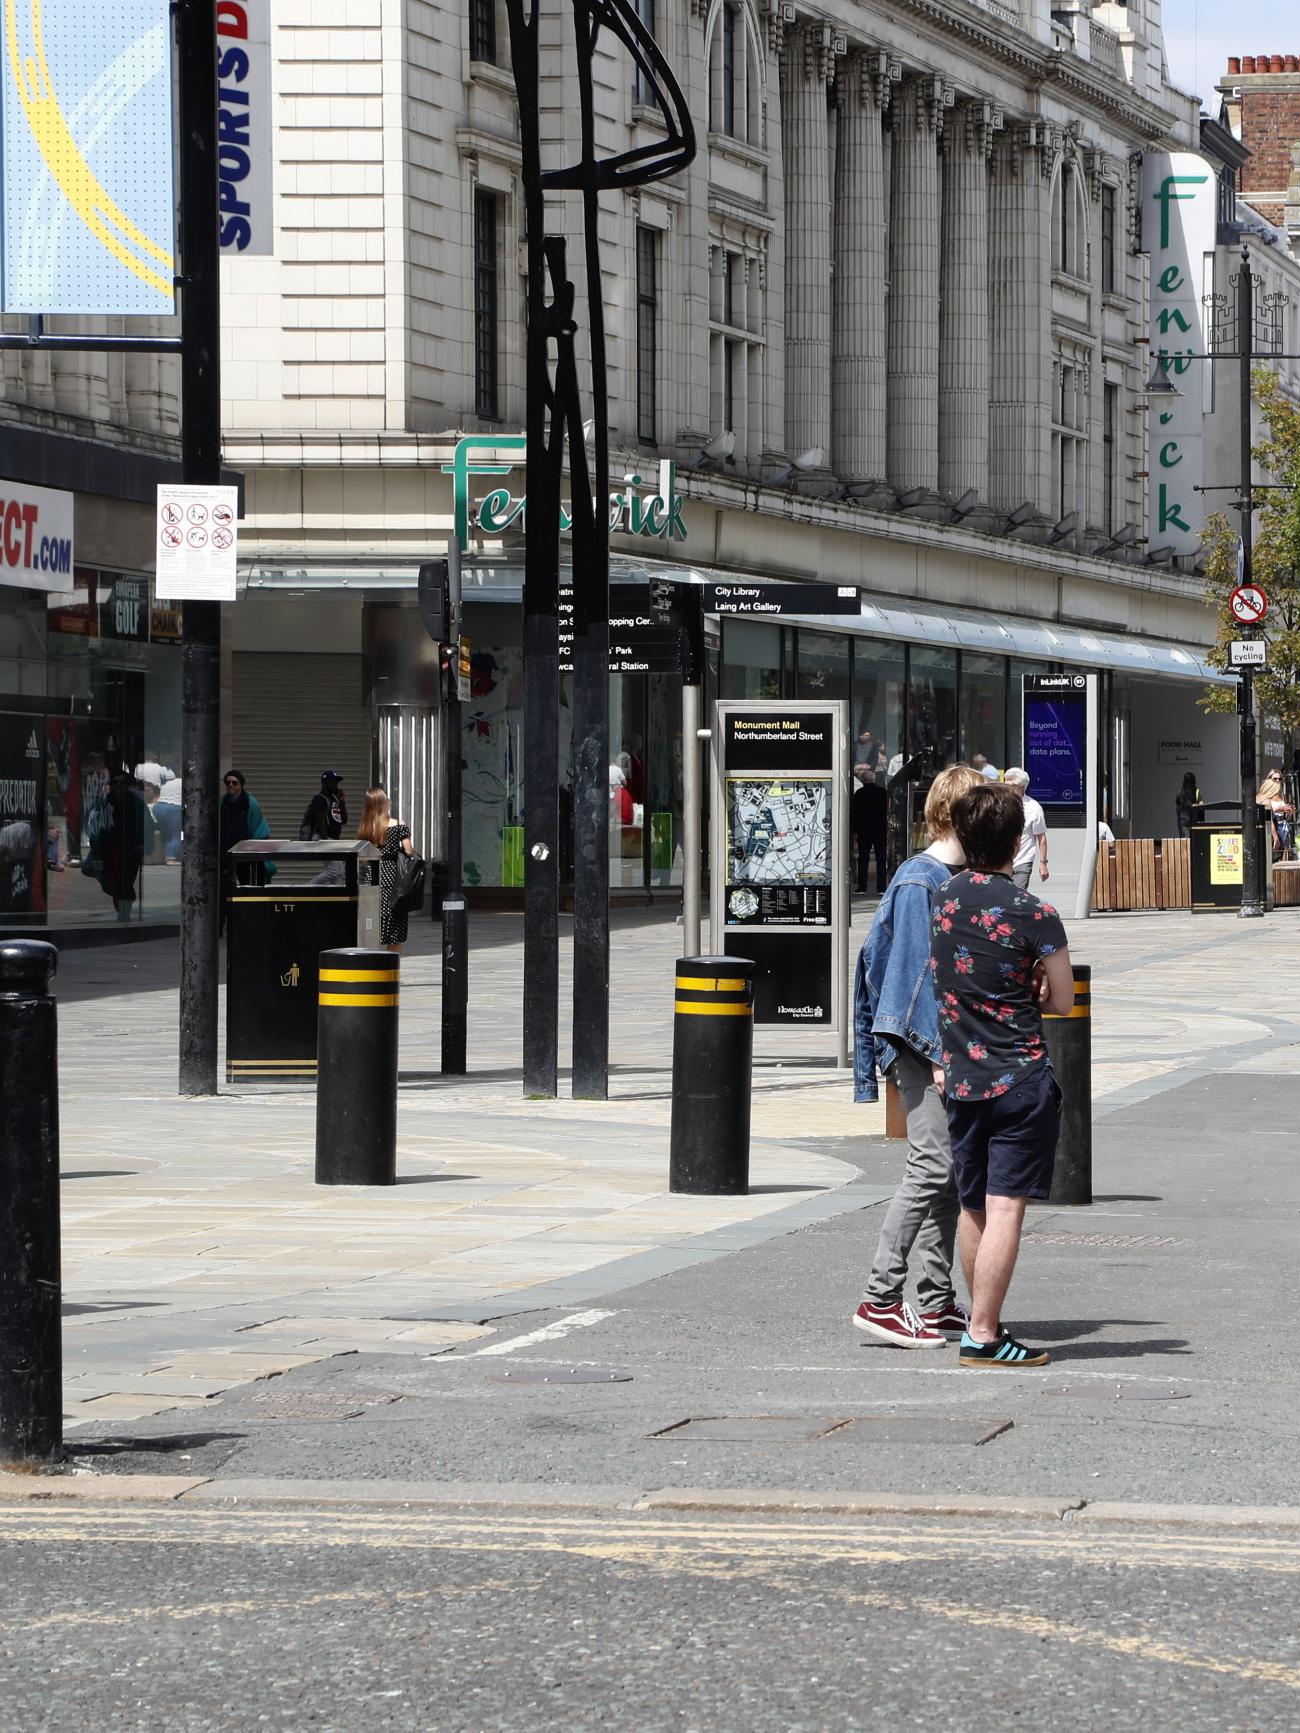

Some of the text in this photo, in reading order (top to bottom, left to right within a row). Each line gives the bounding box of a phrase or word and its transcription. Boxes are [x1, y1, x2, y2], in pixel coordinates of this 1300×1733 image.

[218, 46, 251, 251] SPORTS
[441, 436, 688, 551] Feick
[715, 586, 760, 597] City Library
[715, 601, 781, 613] Laing Art Gallery
[115, 601, 140, 635] GOLF
[608, 617, 634, 626] opping
[558, 631, 574, 642] aysi
[559, 646, 632, 655] FC Park
[1234, 653, 1264, 662] cycling
[621, 662, 649, 670] Station
[734, 721, 800, 729] Monument Mall
[1030, 721, 1058, 731] Beyond
[734, 732, 823, 740] Northumberland Street
[1030, 731, 1058, 741] running
[1030, 738, 1042, 747] out
[1043, 737, 1053, 747] of
[1160, 741, 1203, 749] FOOD HALL
[1030, 748, 1071, 758] data plans.
[0, 780, 37, 815] PREDATOR
[1217, 845, 1239, 855] ZERO
